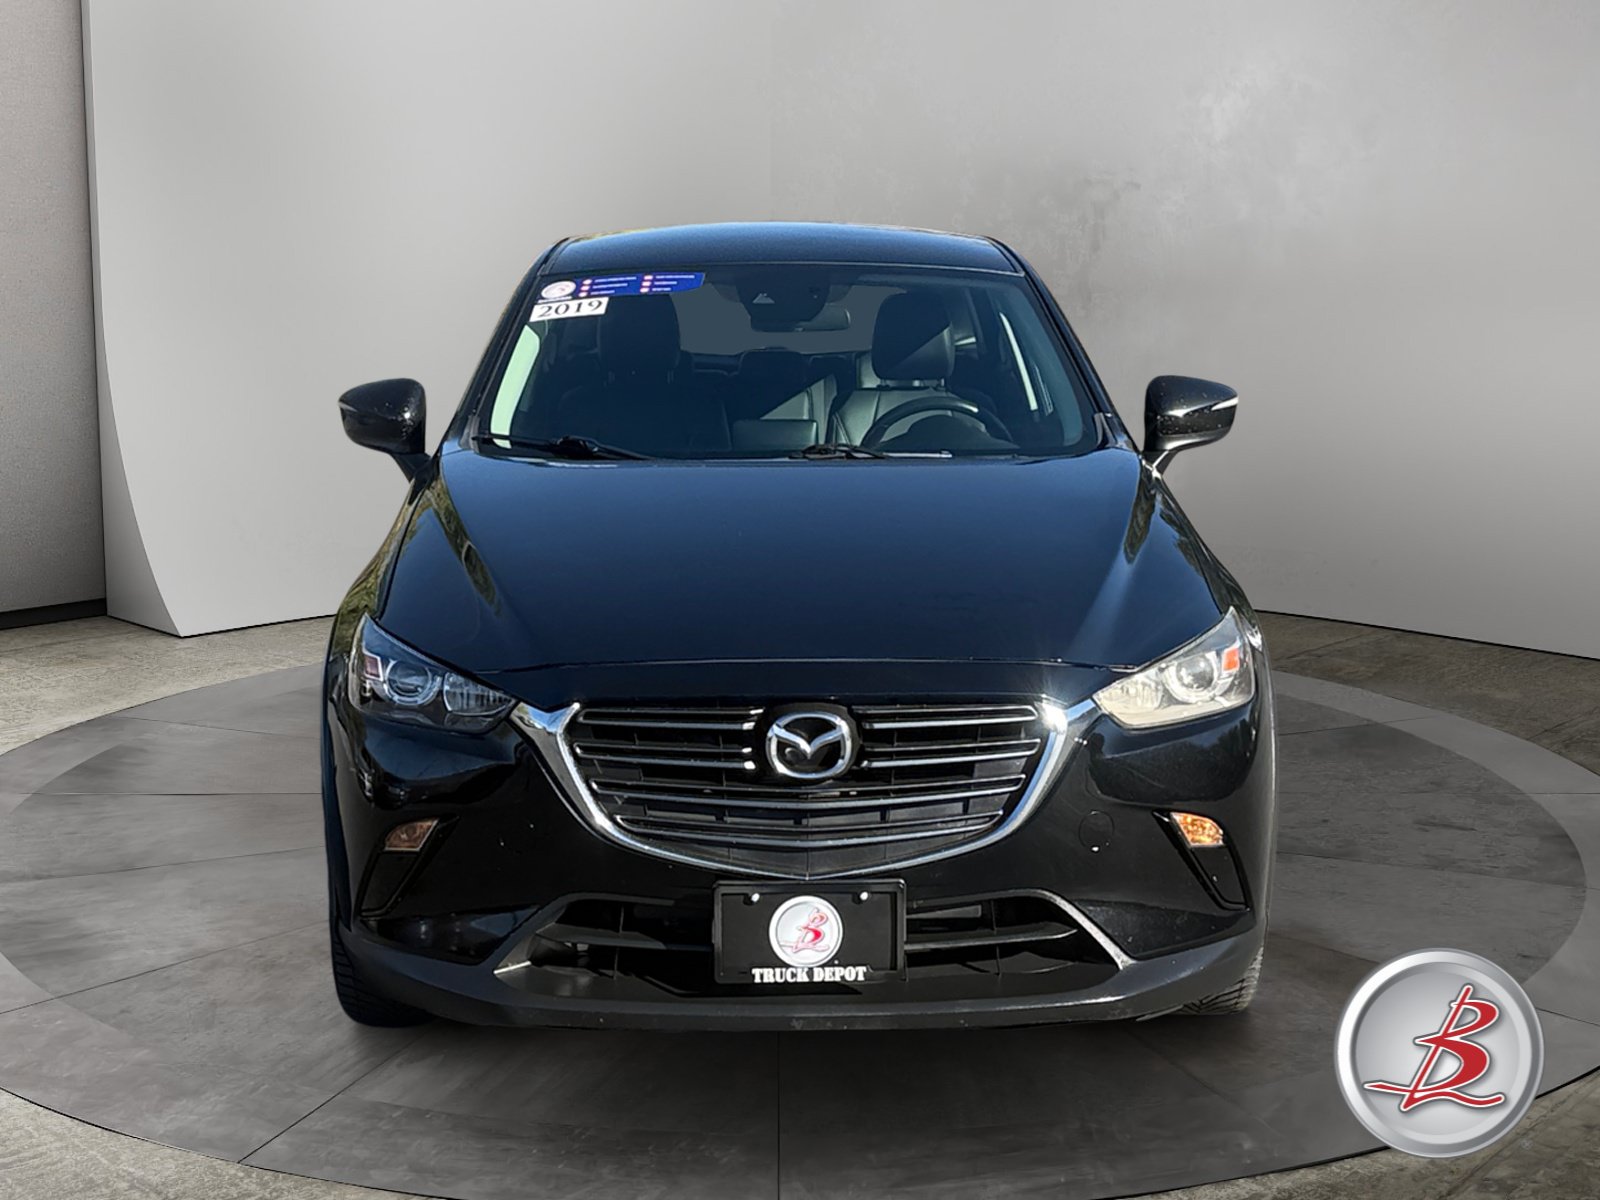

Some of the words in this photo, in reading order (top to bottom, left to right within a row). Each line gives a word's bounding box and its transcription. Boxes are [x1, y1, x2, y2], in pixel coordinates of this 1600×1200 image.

[537, 299, 603, 318] 2019
[751, 967, 810, 983] TRUCK
[812, 966, 867, 981] DEPOT
